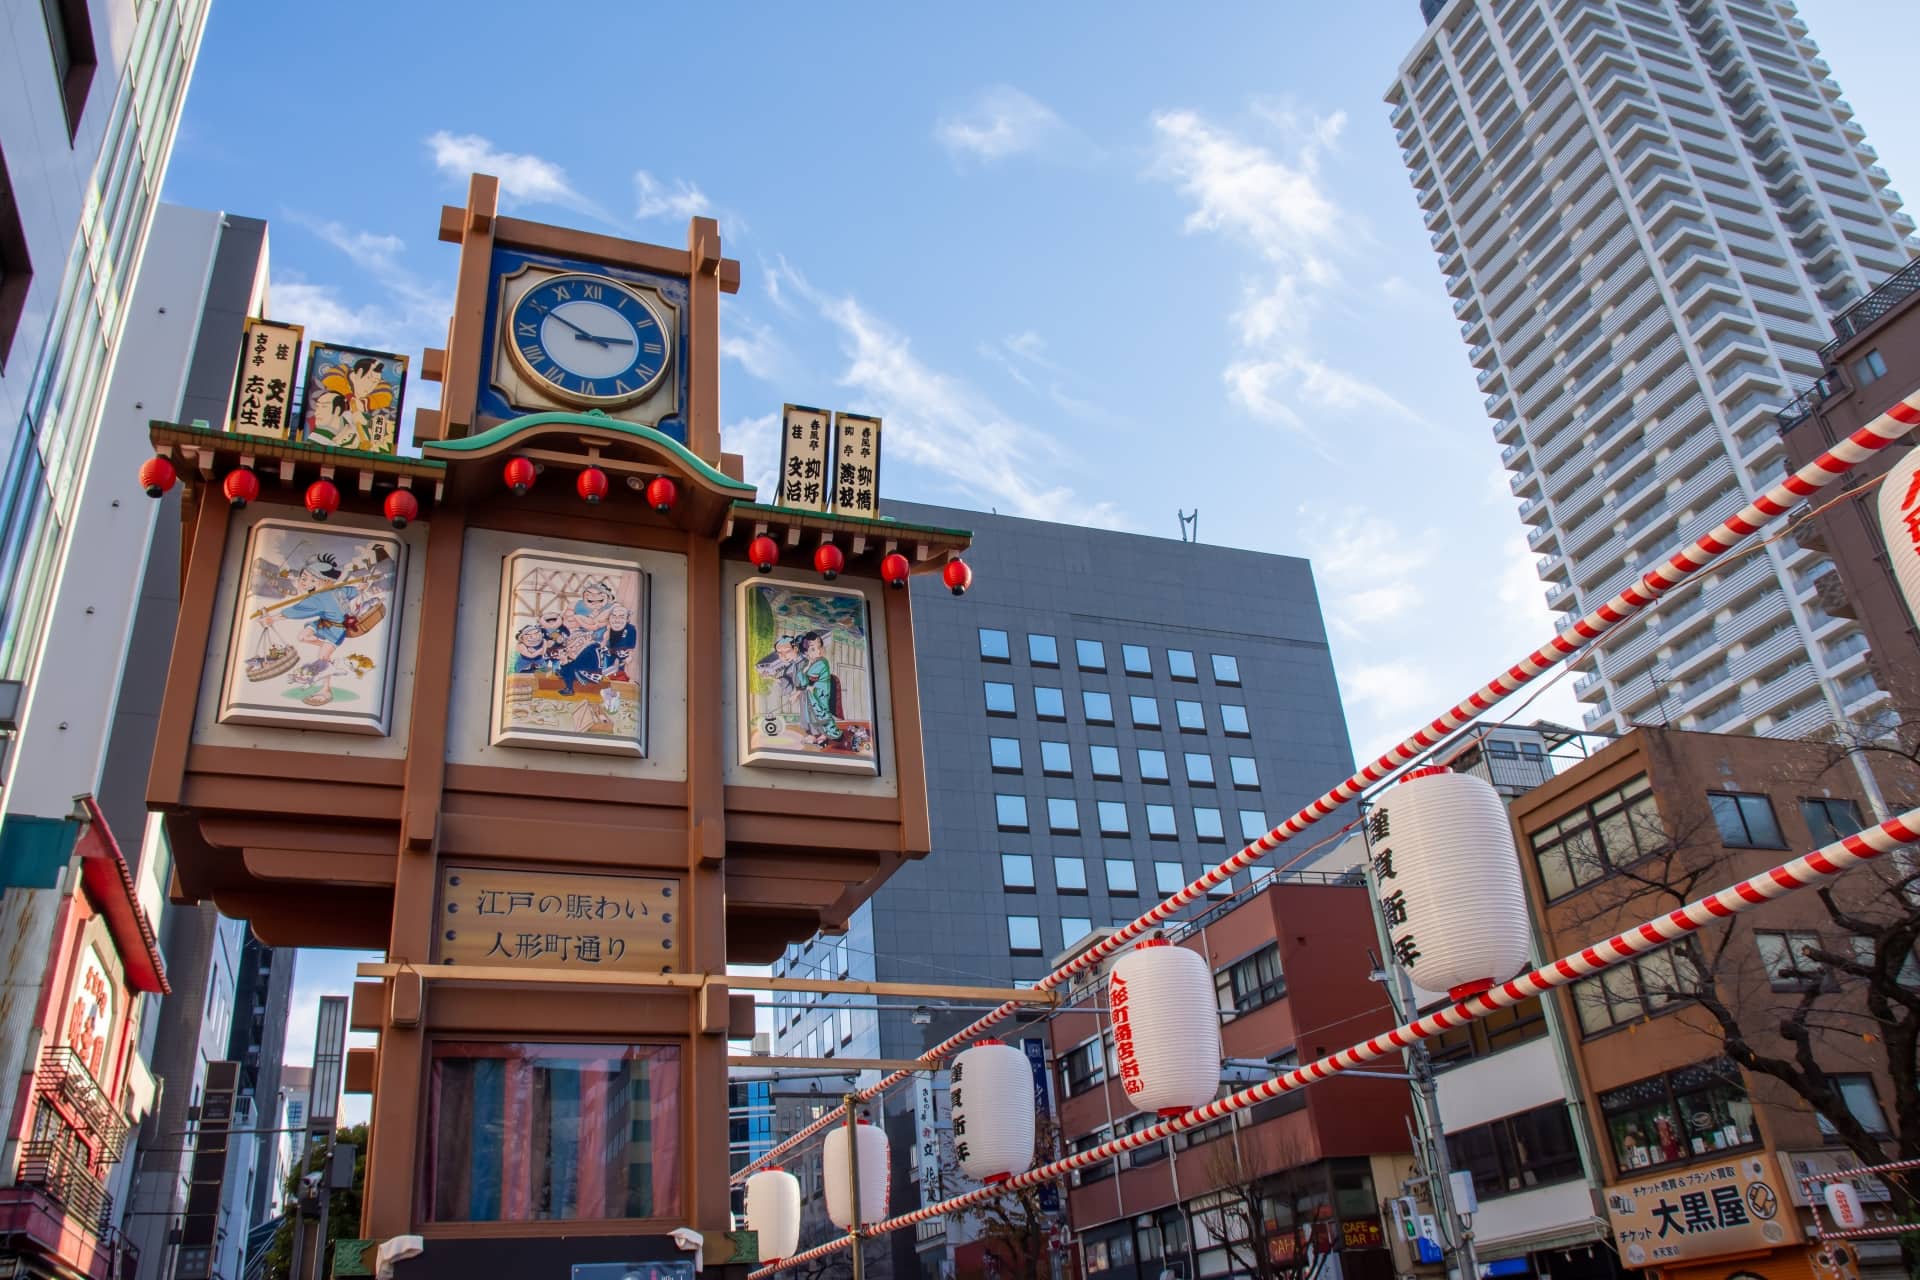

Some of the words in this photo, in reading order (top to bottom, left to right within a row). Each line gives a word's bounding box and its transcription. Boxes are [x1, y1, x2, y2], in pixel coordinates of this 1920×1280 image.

[583, 284, 603, 300] XII
[519, 322, 537, 337] IX
[636, 319, 654, 329] II
[252, 333, 268, 366] 古今亭
[643, 343, 662, 354] III
[544, 366, 566, 386] VII
[635, 364, 655, 382] IV
[580, 380, 595, 395] VI
[615, 379, 632, 395] V
[809, 419, 821, 451] 春風亭
[861, 427, 871, 458] 春風亭
[804, 458, 821, 504] 柳好
[856, 465, 872, 511] 柳橋
[477, 889, 648, 920] 江戸の賑わい
[487, 931, 627, 963] 人形町通り
[1651, 1184, 1750, 1239] 大黒屋
[1343, 1221, 1369, 1234] CAFE
[1620, 1227, 1652, 1243] チケット
[1345, 1234, 1367, 1246] BAR
